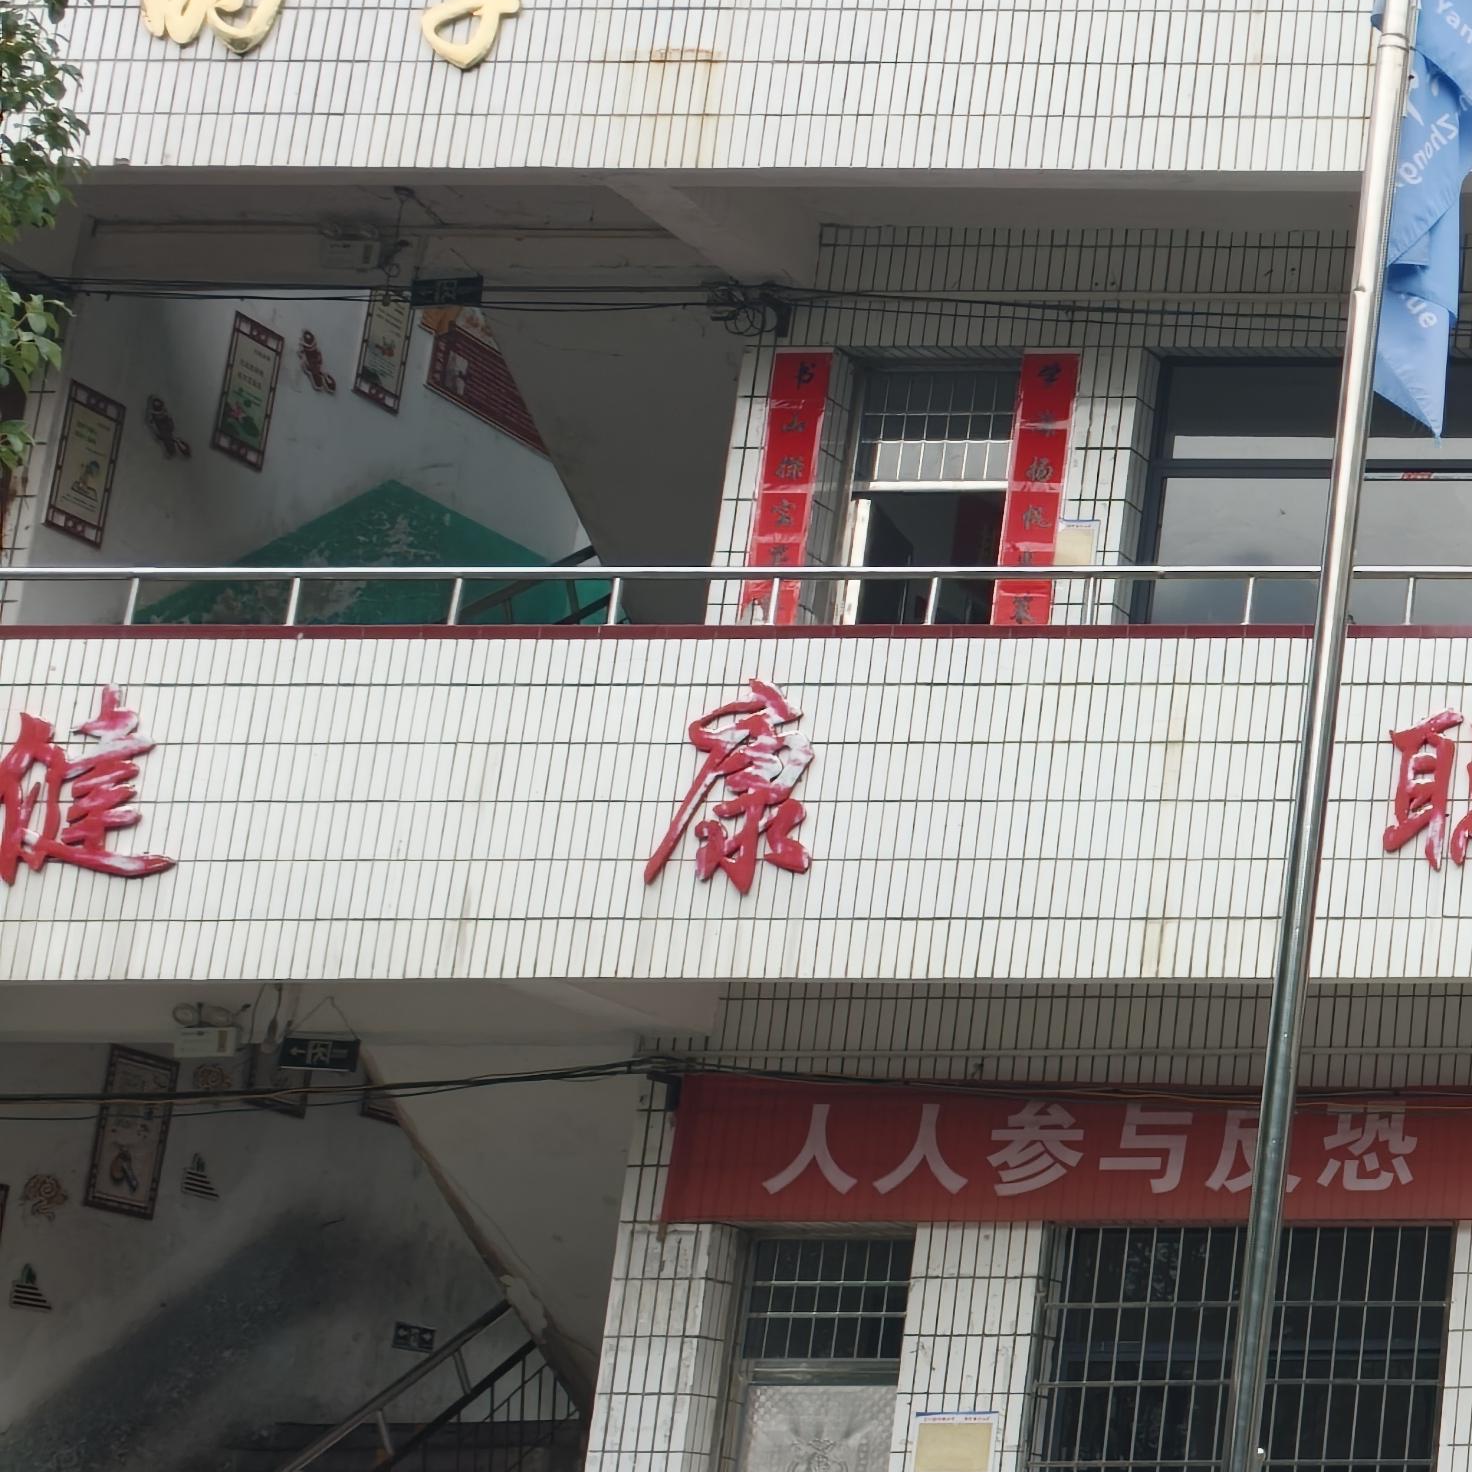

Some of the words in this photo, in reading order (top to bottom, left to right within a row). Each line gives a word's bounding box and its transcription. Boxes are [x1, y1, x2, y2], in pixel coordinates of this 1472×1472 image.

[761, 1098, 1419, 1197] 人人参与反恐
